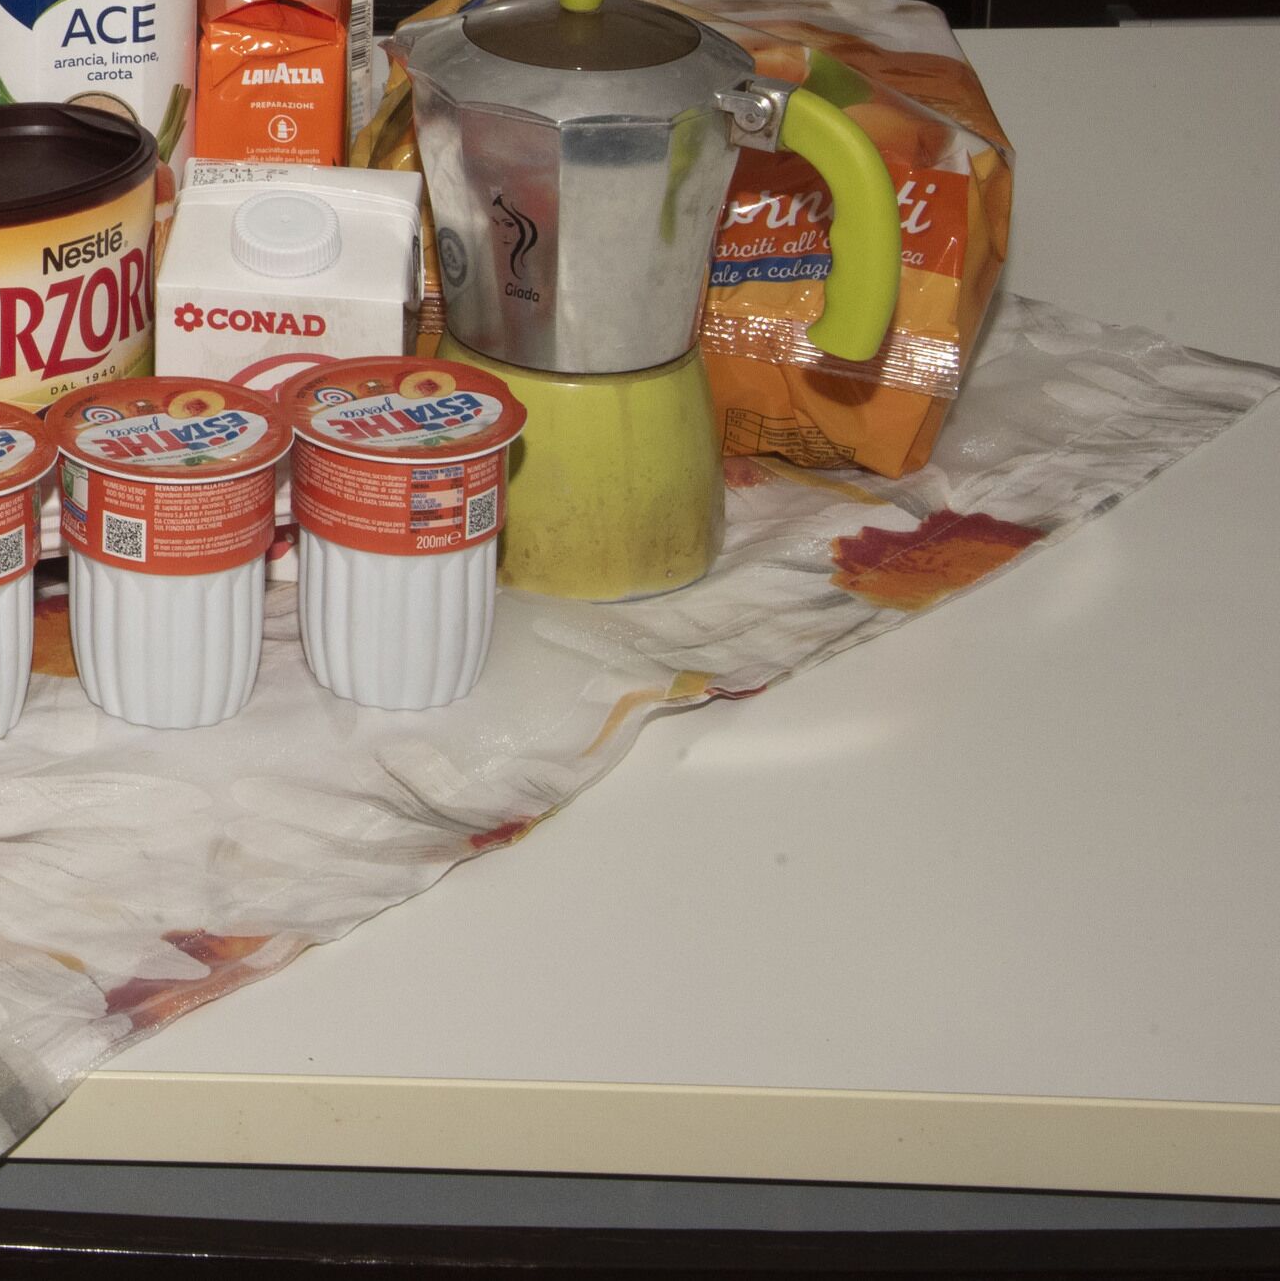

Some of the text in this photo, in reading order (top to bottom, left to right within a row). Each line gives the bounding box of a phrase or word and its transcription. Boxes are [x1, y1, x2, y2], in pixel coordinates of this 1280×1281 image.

[61, 3, 157, 48] ACE
[53, 50, 160, 70] arancia, limone,
[86, 68, 134, 82] carota
[241, 61, 325, 86] LAVAZZA
[249, 100, 316, 111] PREPARAZIONE
[42, 221, 124, 276] Nestlé
[747, 267, 762, 278] a
[504, 282, 541, 302] Giada
[205, 307, 327, 338] CONAD
[50, 364, 117, 396] DAL 1940
[339, 397, 394, 419] pesca
[104, 416, 161, 437] pesca
